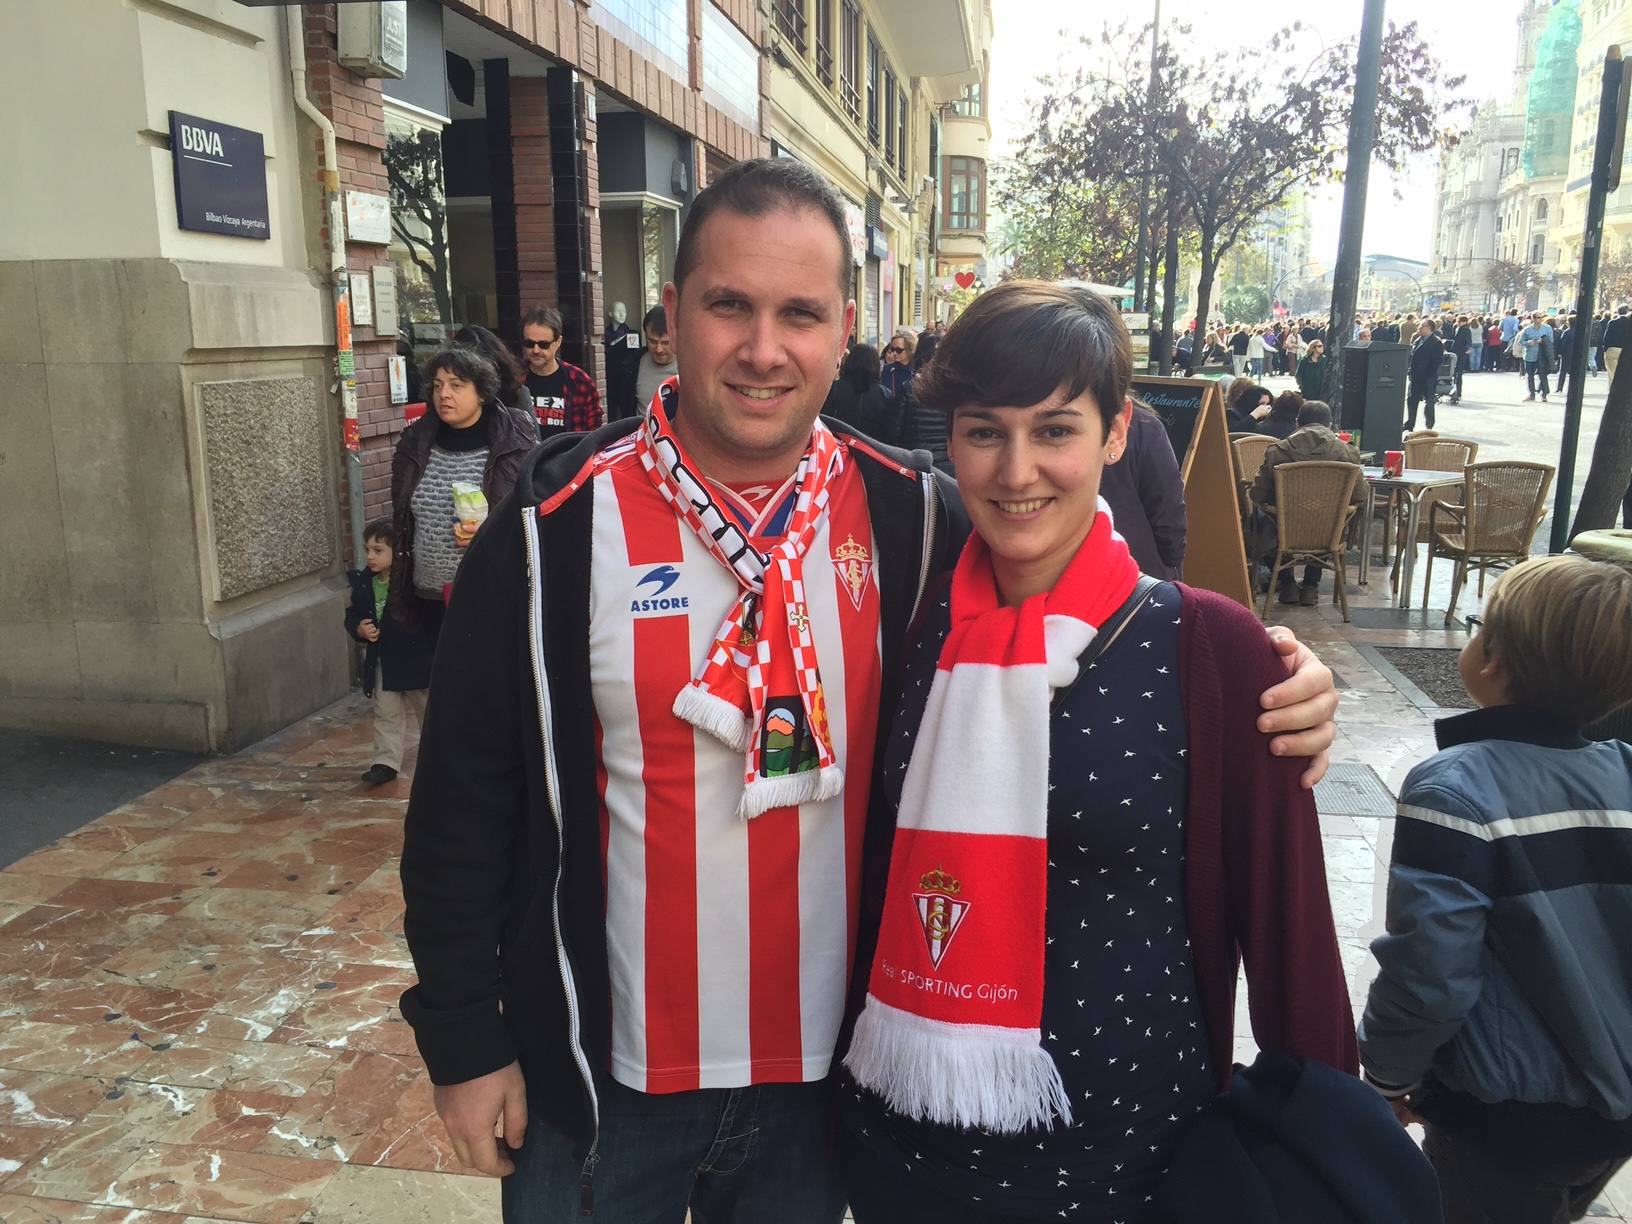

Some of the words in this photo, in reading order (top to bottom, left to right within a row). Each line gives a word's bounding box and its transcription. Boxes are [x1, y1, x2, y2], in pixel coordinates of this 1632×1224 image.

[181, 124, 224, 157] BBVA
[205, 211, 222, 223] Bilbao
[222, 214, 240, 227] Vizcaya
[241, 217, 266, 229] Argentaria
[630, 596, 689, 613] ASTORE
[900, 969, 974, 999] SPORTING
[977, 983, 1018, 1004] Gijón
